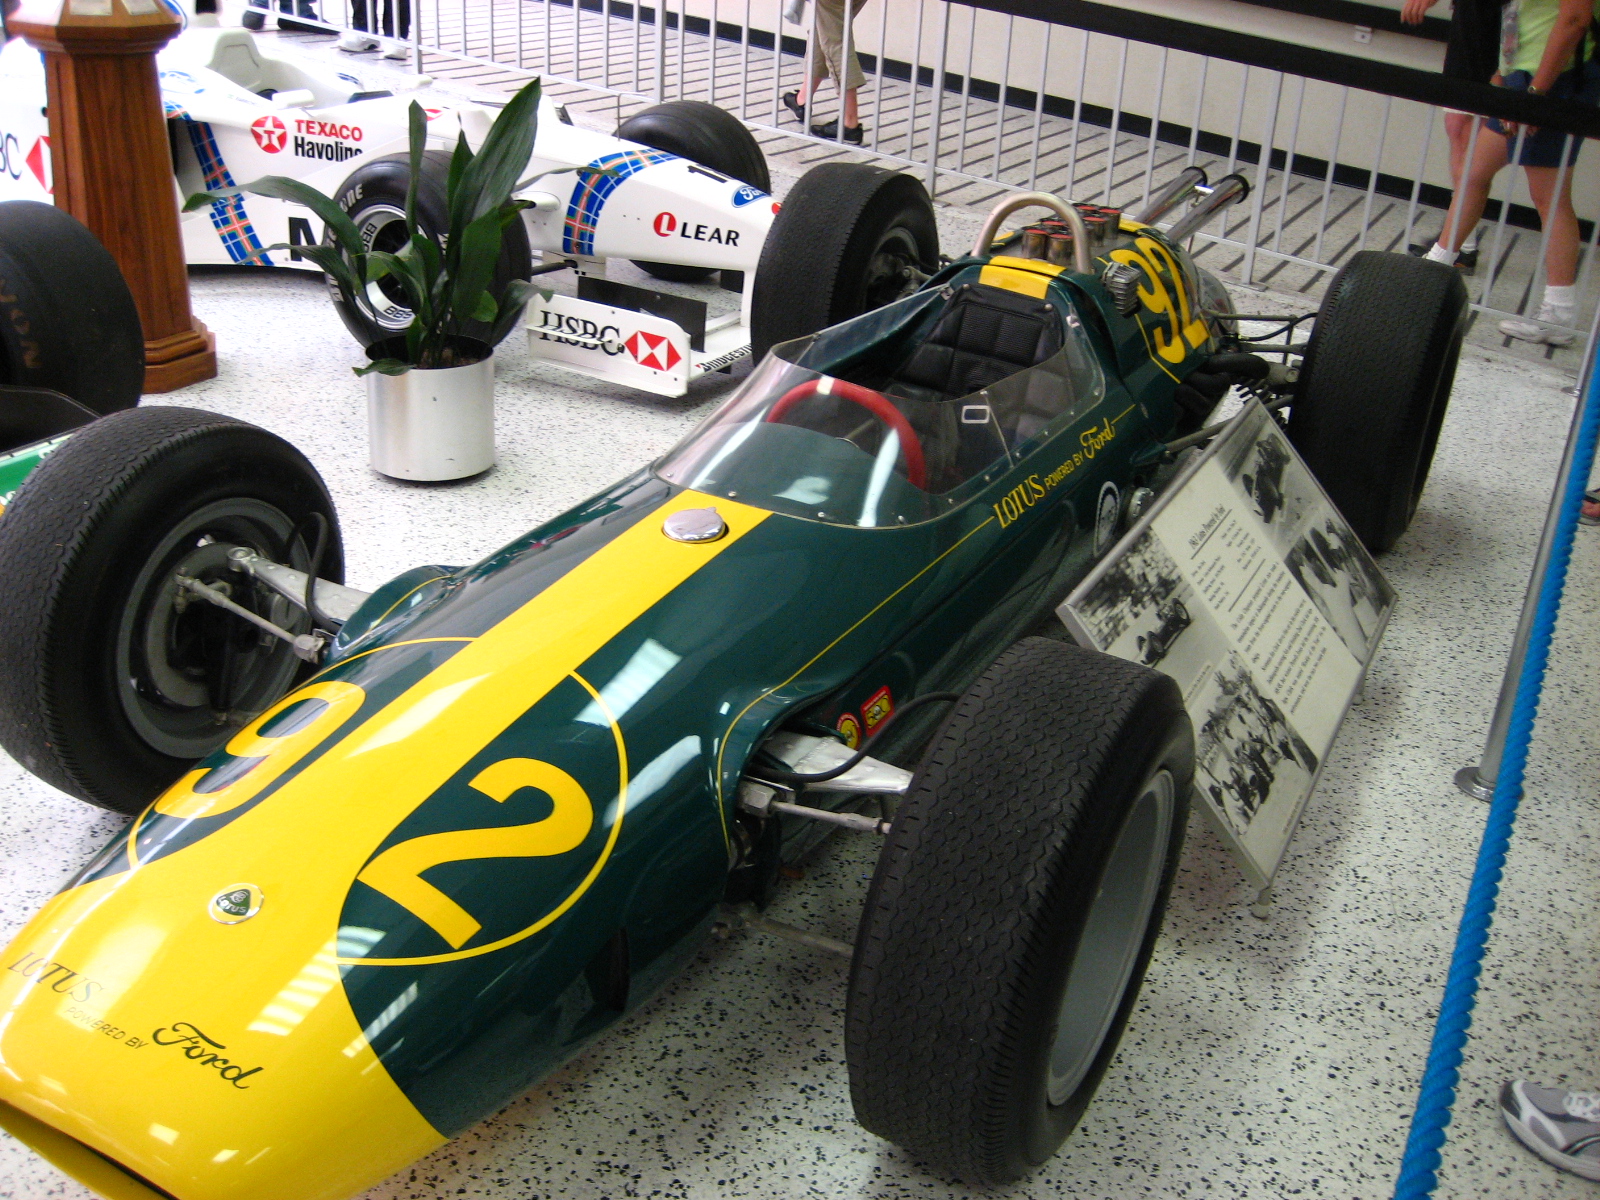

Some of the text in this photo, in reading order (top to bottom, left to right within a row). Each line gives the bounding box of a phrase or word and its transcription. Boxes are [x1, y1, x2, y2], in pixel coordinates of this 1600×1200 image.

[294, 119, 363, 142] TEXACO
[680, 222, 740, 247] LEAR
[1109, 237, 1210, 364] 92
[539, 310, 622, 356] HSBC
[993, 417, 1117, 529] LOTUS POWERED BY Ford
[8, 952, 105, 1003] LOTUS
[66, 1006, 264, 1090] POWERED BY Ford
